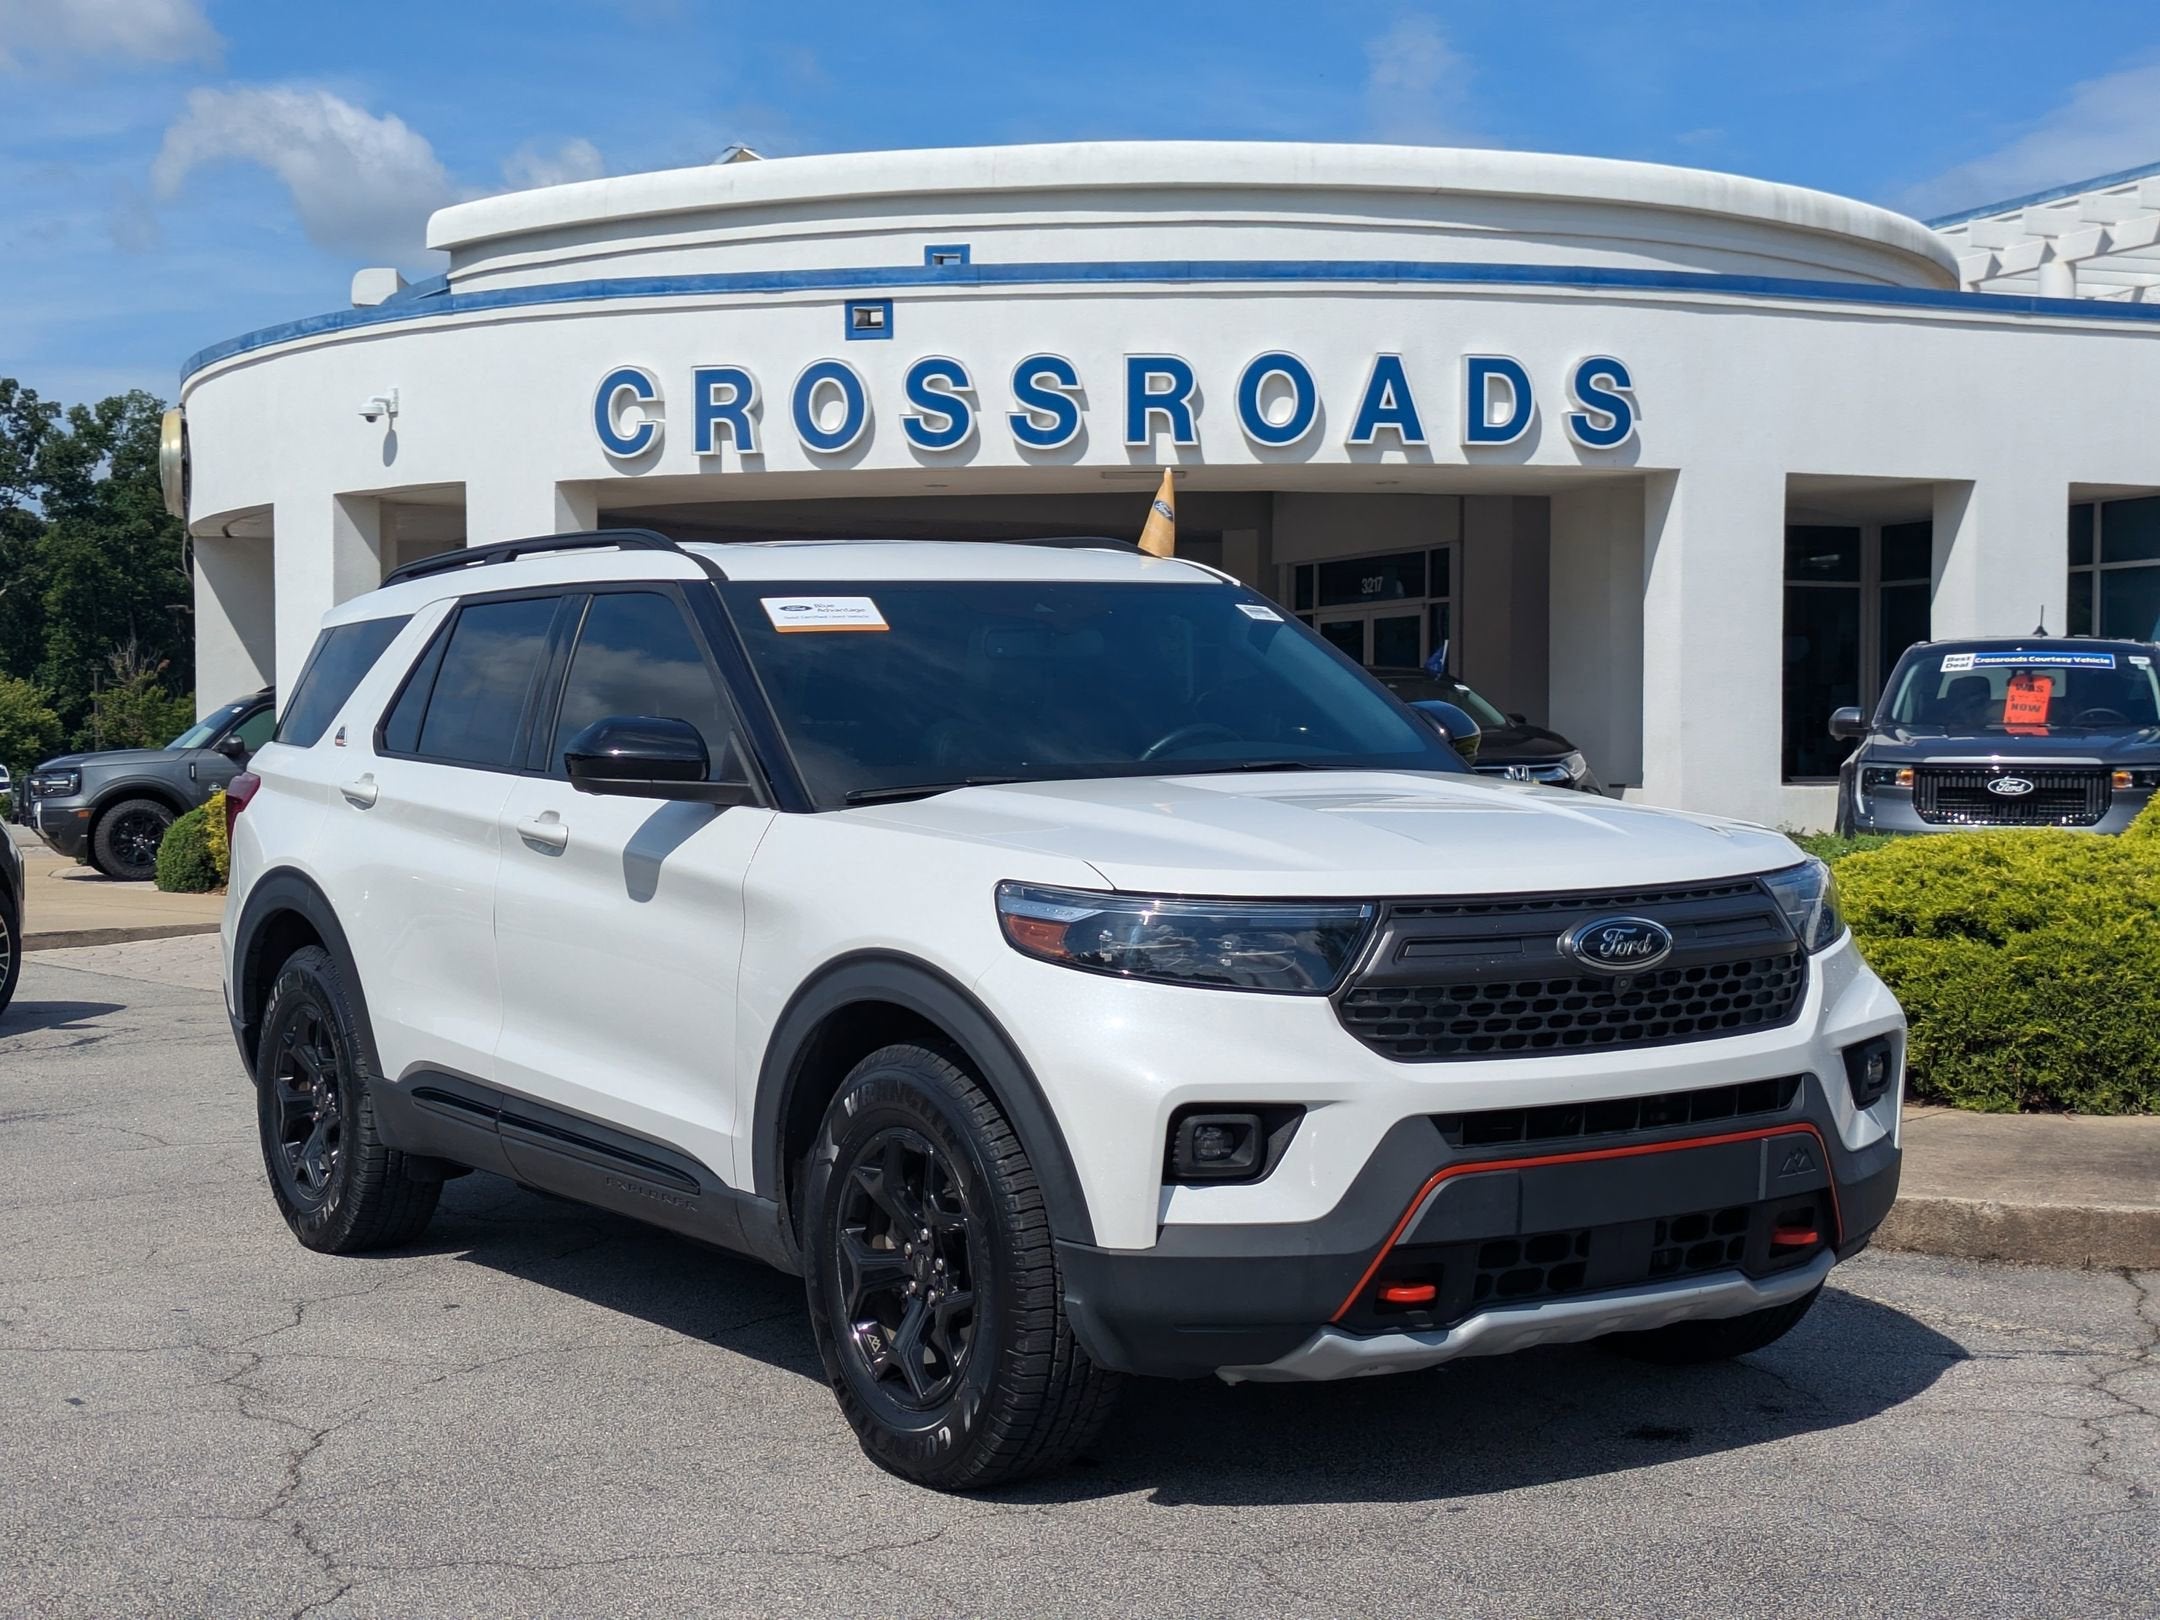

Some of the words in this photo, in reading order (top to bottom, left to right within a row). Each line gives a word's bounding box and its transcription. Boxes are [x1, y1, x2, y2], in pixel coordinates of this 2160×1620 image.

[593, 350, 1640, 459] CROSSROADS
[1361, 576, 1383, 594] 3217
[1974, 656, 2027, 664] Crossroads
[2028, 656, 2072, 664] Courtesy
[2011, 703, 2042, 713] NOW
[1995, 779, 2026, 792] Ford
[1599, 927, 1653, 958] Ford
[605, 1176, 698, 1213] EXPLORER
